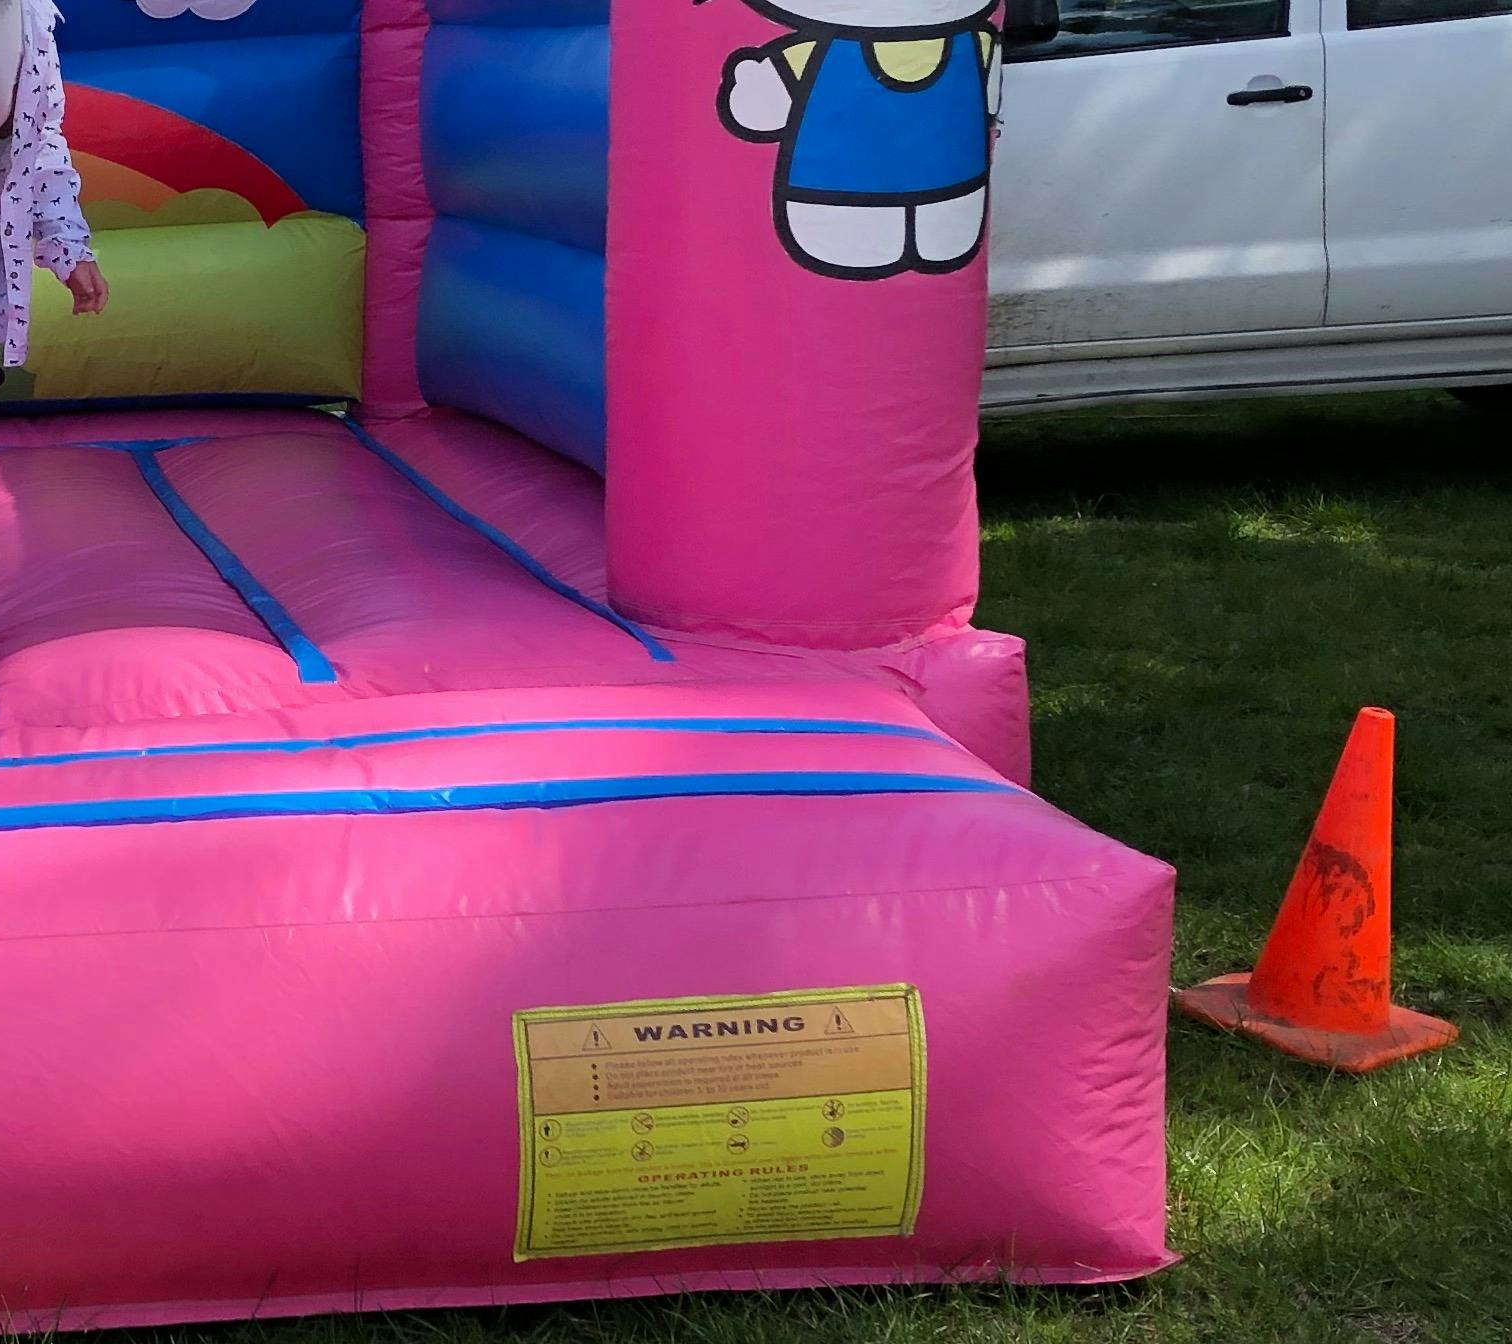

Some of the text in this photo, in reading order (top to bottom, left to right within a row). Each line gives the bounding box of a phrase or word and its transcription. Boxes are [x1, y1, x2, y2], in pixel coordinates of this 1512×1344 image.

[634, 1017, 805, 1042] WARNING
[637, 1168, 744, 1184] OPERATING
[749, 1163, 809, 1177] RULES
